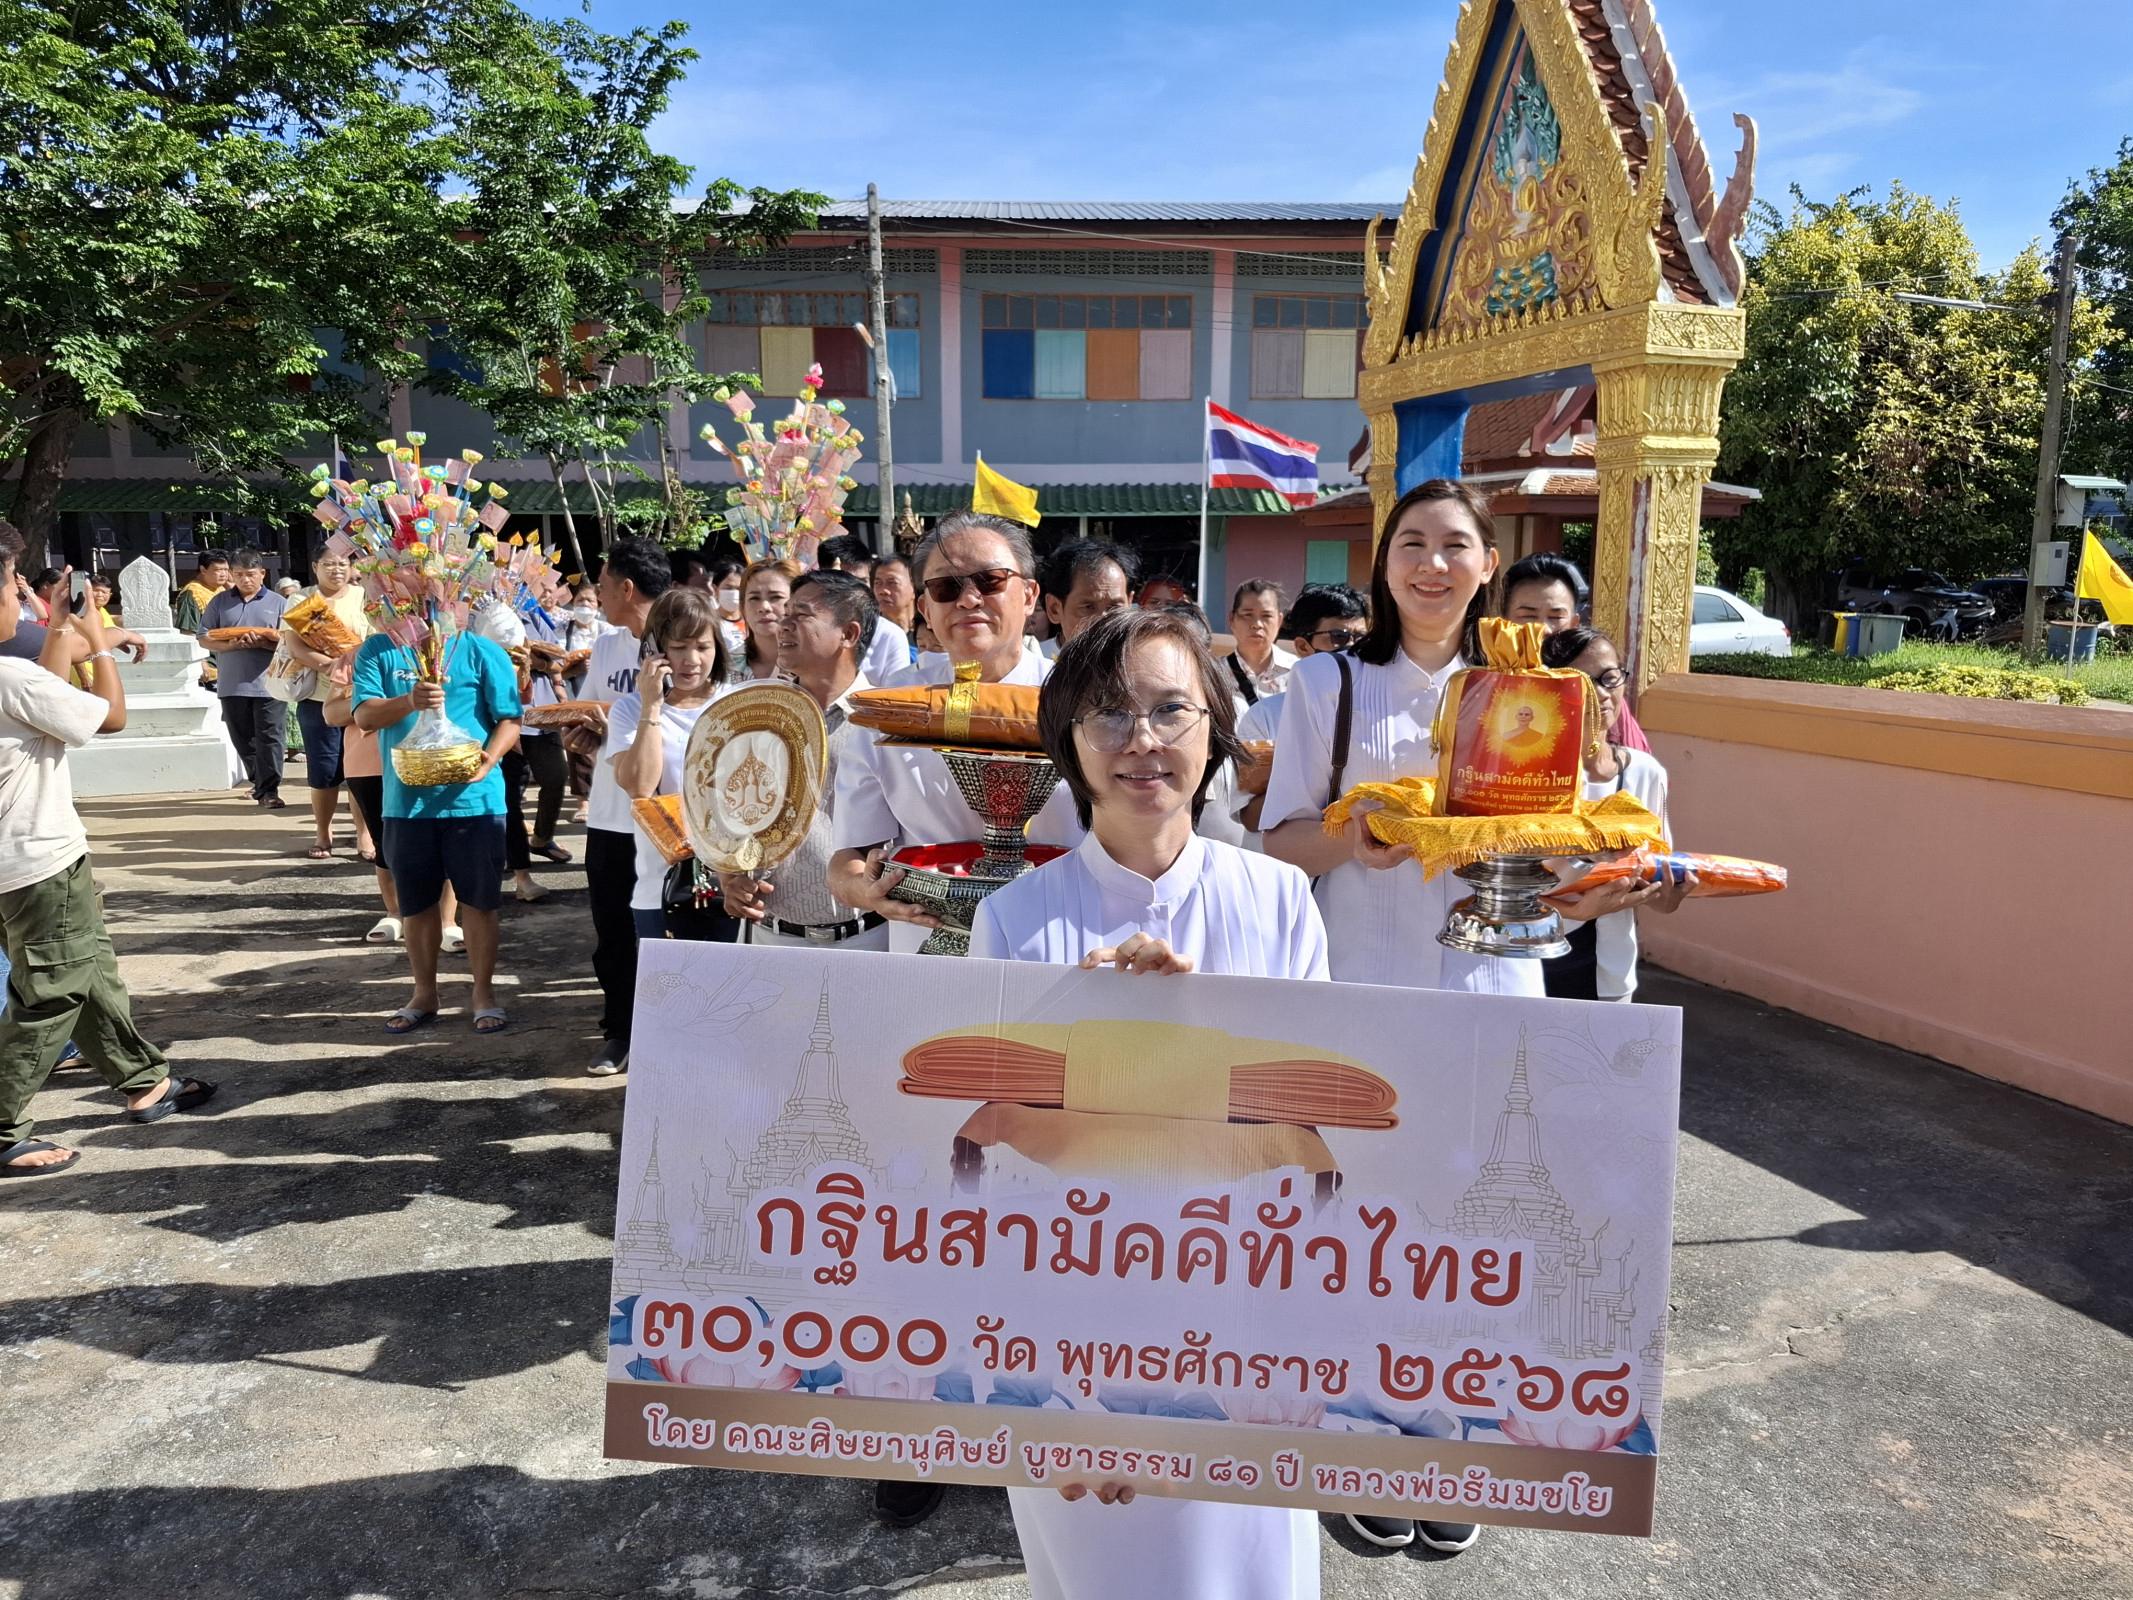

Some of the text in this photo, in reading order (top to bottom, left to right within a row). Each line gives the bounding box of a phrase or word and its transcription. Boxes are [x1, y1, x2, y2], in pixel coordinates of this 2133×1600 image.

[1457, 766, 1573, 787] กฐินสามัคคีทั่วไทย
[1488, 789, 1500, 799] วัด
[757, 1172, 1522, 1307] กฐินสามัคคีทั่วไทย
[643, 1300, 1631, 1418] ๓๐,๐๐๐ วัด พุทธศักราช ๒๕๖๘
[647, 1407, 1608, 1513] โดย คณะศิษยานุศิษย์ บูชาธรรม ๘๑ ปี หลวงพ่อธัมมชโย
